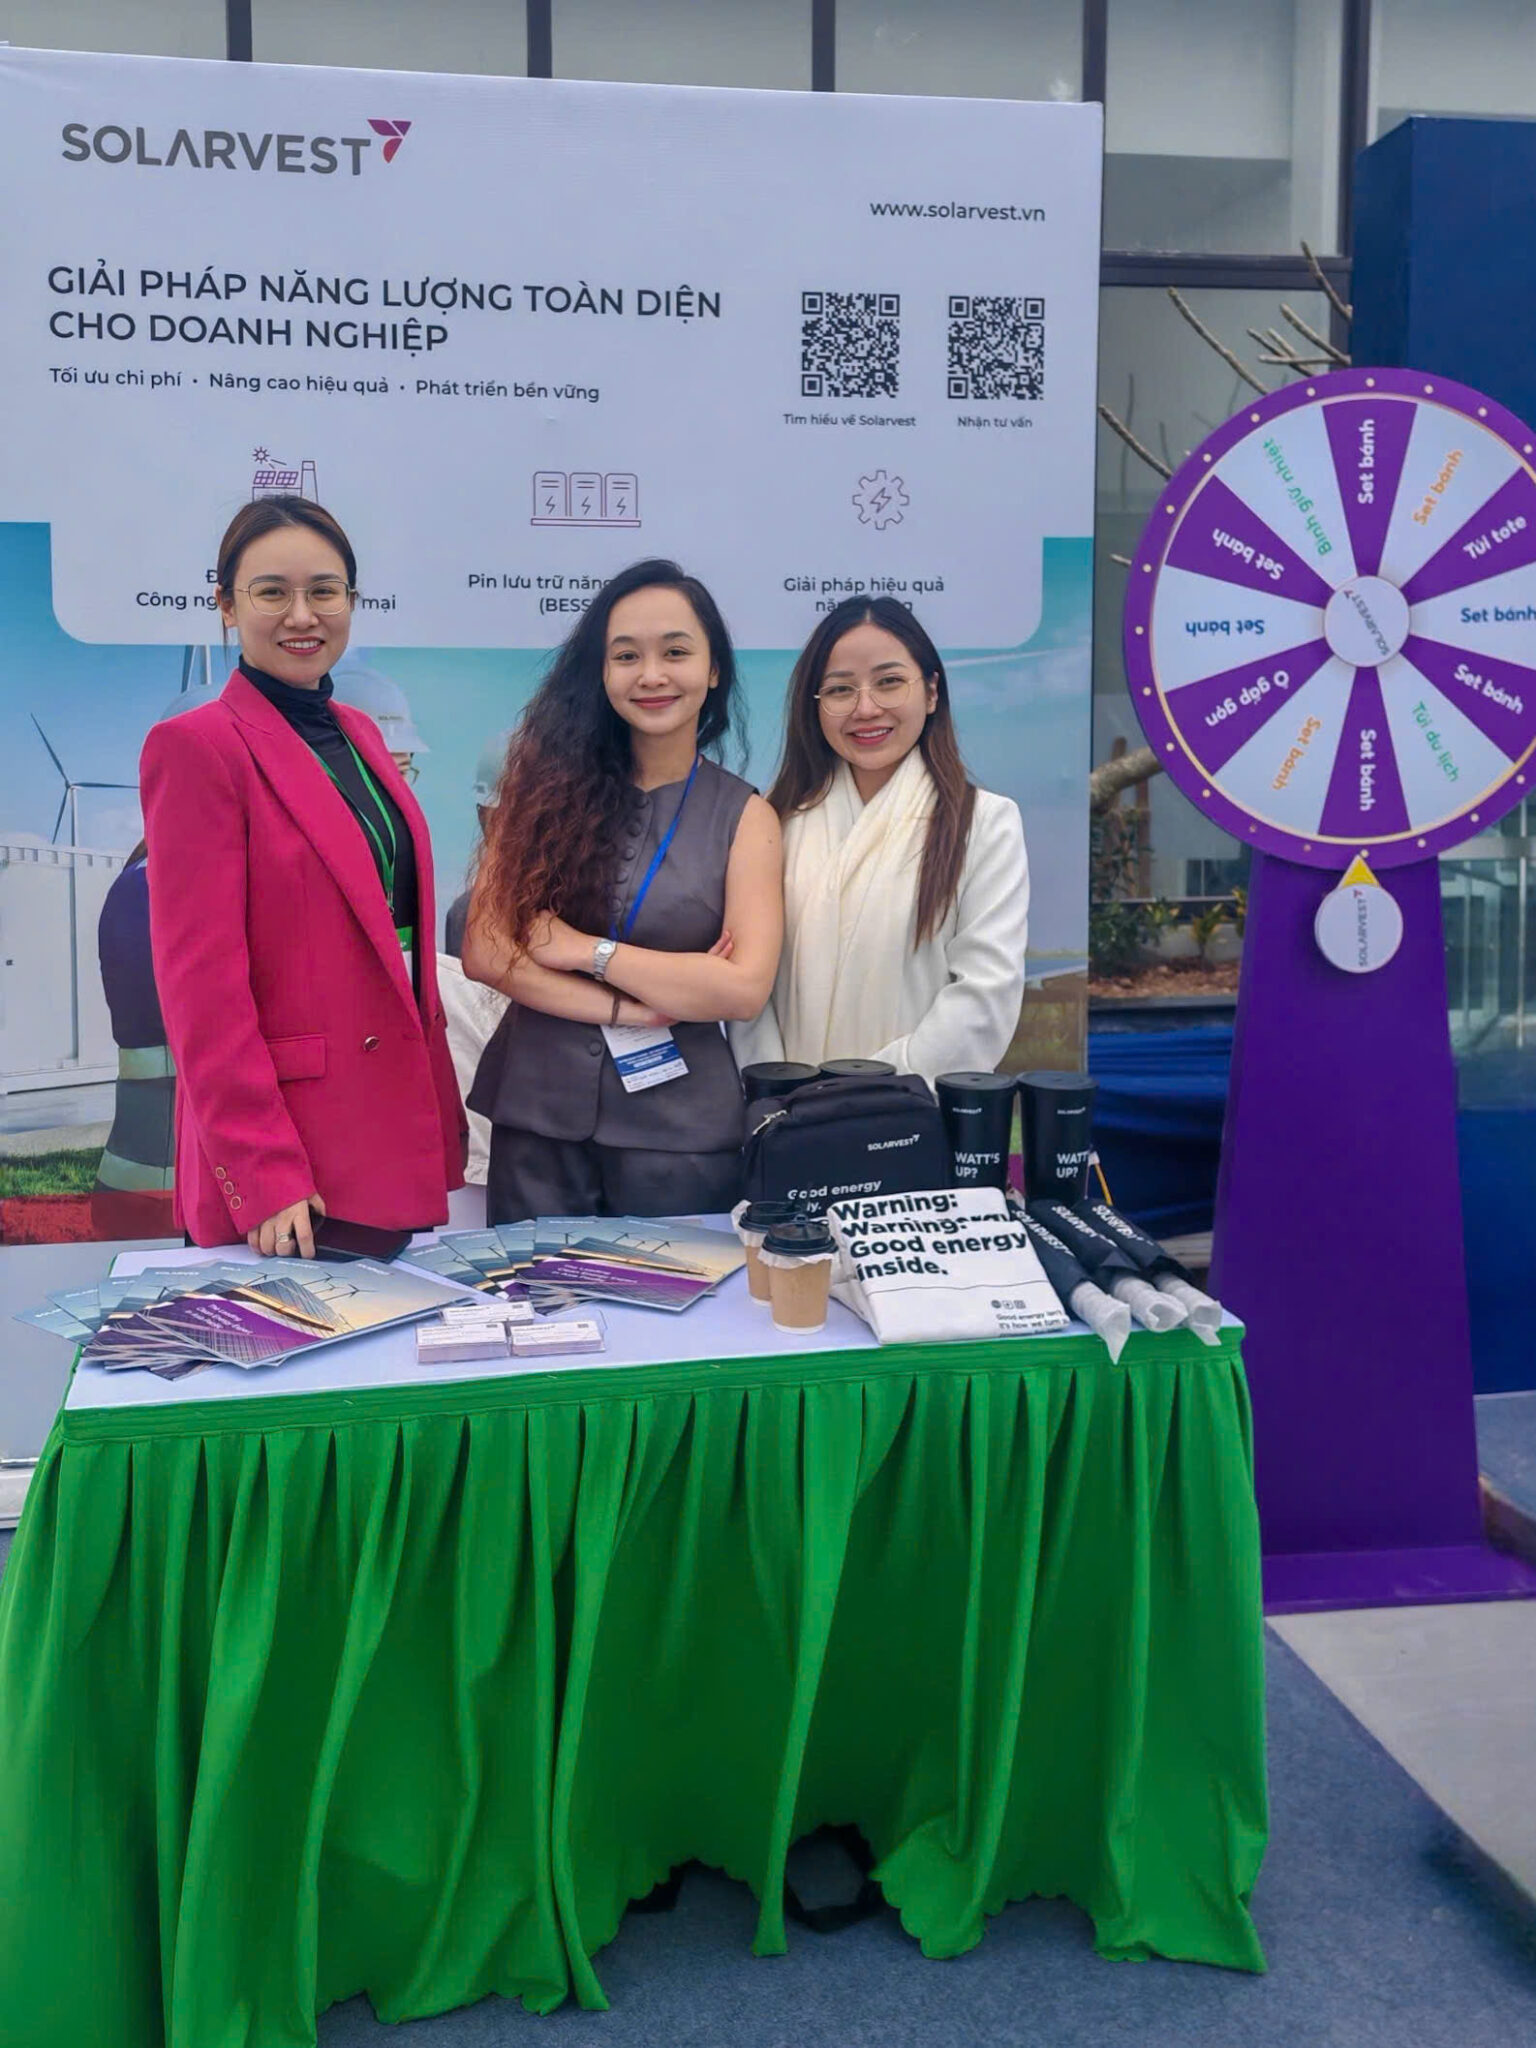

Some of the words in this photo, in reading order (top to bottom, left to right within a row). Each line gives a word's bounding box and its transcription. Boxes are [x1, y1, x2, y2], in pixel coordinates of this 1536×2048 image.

[62, 123, 371, 175] SOLARVEST
[870, 202, 1045, 221] www.solarvest.vn
[48, 259, 124, 295] GIẢI
[141, 266, 246, 299] PHÁP
[261, 269, 368, 305] NĂNG
[384, 277, 511, 315] LƯỢNG
[523, 281, 622, 315] TOÀN
[638, 285, 720, 323] DIỆN
[50, 311, 135, 340] CHO
[150, 315, 291, 346] DOANH
[307, 318, 447, 357] NGHIỆP
[49, 367, 77, 383] Tối
[85, 370, 108, 384] ưu
[116, 370, 143, 385] chi
[151, 371, 181, 389] phí
[210, 373, 260, 392] Nâng
[266, 377, 301, 391] cao
[307, 376, 347, 394] hiệu
[353, 377, 388, 395] quả
[417, 380, 459, 395] Phát
[465, 381, 507, 396] triển
[514, 382, 547, 397] bền
[553, 384, 599, 403] vững
[858, 414, 917, 427] Solarvest
[957, 416, 991, 428] Nhận
[993, 417, 1008, 428] tư
[1009, 416, 1033, 428] vấn
[1359, 419, 1374, 469] bánh
[1359, 474, 1373, 504] Set
[1413, 493, 1440, 525] Set
[1430, 449, 1463, 495] bánh
[1491, 515, 1527, 541] tote
[1212, 528, 1255, 561] bánh
[1250, 552, 1285, 580] Set
[469, 574, 497, 588] Pin
[504, 574, 531, 588] lưu
[536, 575, 564, 589] trữ
[784, 576, 815, 591] Giải
[822, 578, 865, 595] pháp
[871, 578, 906, 595] hiệu
[912, 577, 944, 594] quả
[136, 592, 186, 610] Công
[194, 594, 218, 610] ng
[362, 595, 395, 612] mại
[1461, 607, 1489, 623] Set
[1494, 605, 1536, 622] bánh
[1185, 620, 1230, 637] bánh
[1236, 619, 1264, 634] Set
[1349, 596, 1391, 656] SOLARVEST
[1454, 663, 1483, 690] Set
[1483, 680, 1525, 714] bánh
[1205, 698, 1238, 726] gọn
[1298, 716, 1322, 749] Set
[1360, 729, 1377, 760] Set
[1410, 700, 1430, 731] Túi
[1425, 728, 1445, 752] du
[1436, 747, 1460, 782] lịch
[1272, 747, 1305, 790] bánh
[1360, 763, 1377, 811] bánh
[1359, 898, 1368, 967] SOLARVEST
[867, 1138, 913, 1151] SOLARVEST
[1056, 1151, 1089, 1164] WATT
[955, 1152, 1000, 1164] WATT'S
[955, 1167, 978, 1178] UP?
[1056, 1167, 1078, 1178] UP?
[831, 1180, 881, 1195] energy
[833, 1194, 958, 1221] Warning:
[850, 1237, 925, 1258] Good
[933, 1232, 1026, 1254] energy
[856, 1256, 949, 1281] inside.
